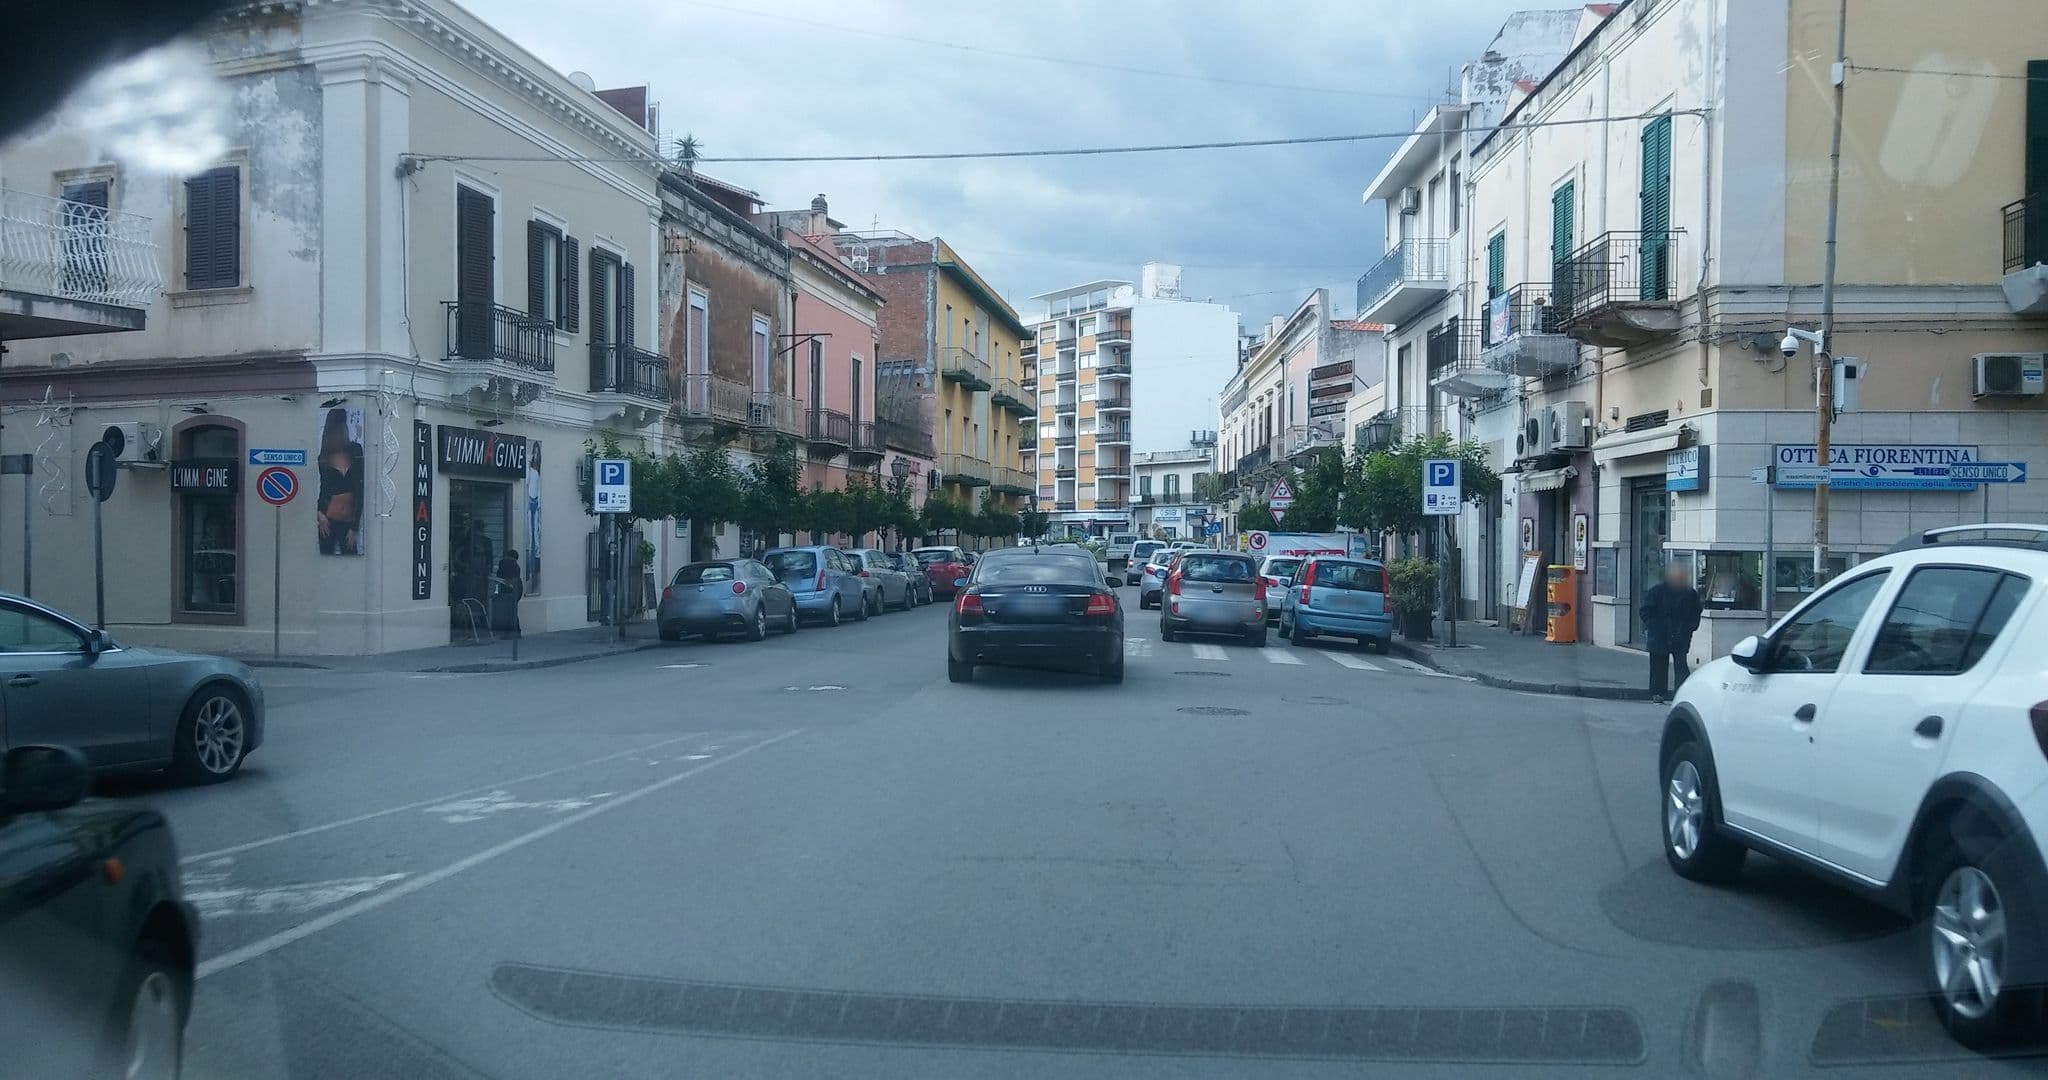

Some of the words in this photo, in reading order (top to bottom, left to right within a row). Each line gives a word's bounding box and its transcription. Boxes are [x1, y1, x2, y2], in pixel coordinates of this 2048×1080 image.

[264, 453, 282, 461] SENSO
[446, 435, 525, 469] L'IMMAGINE
[1780, 448, 1850, 464] OTTCA
[1854, 448, 1971, 465] FIORENTINA
[173, 467, 229, 488] L'IMMAGINE
[606, 464, 620, 483] P
[1434, 464, 1450, 485] P
[1952, 466, 1979, 478] SENSO
[1983, 466, 2008, 478] UNICO
[416, 427, 428, 595] L'IMMAGINE
